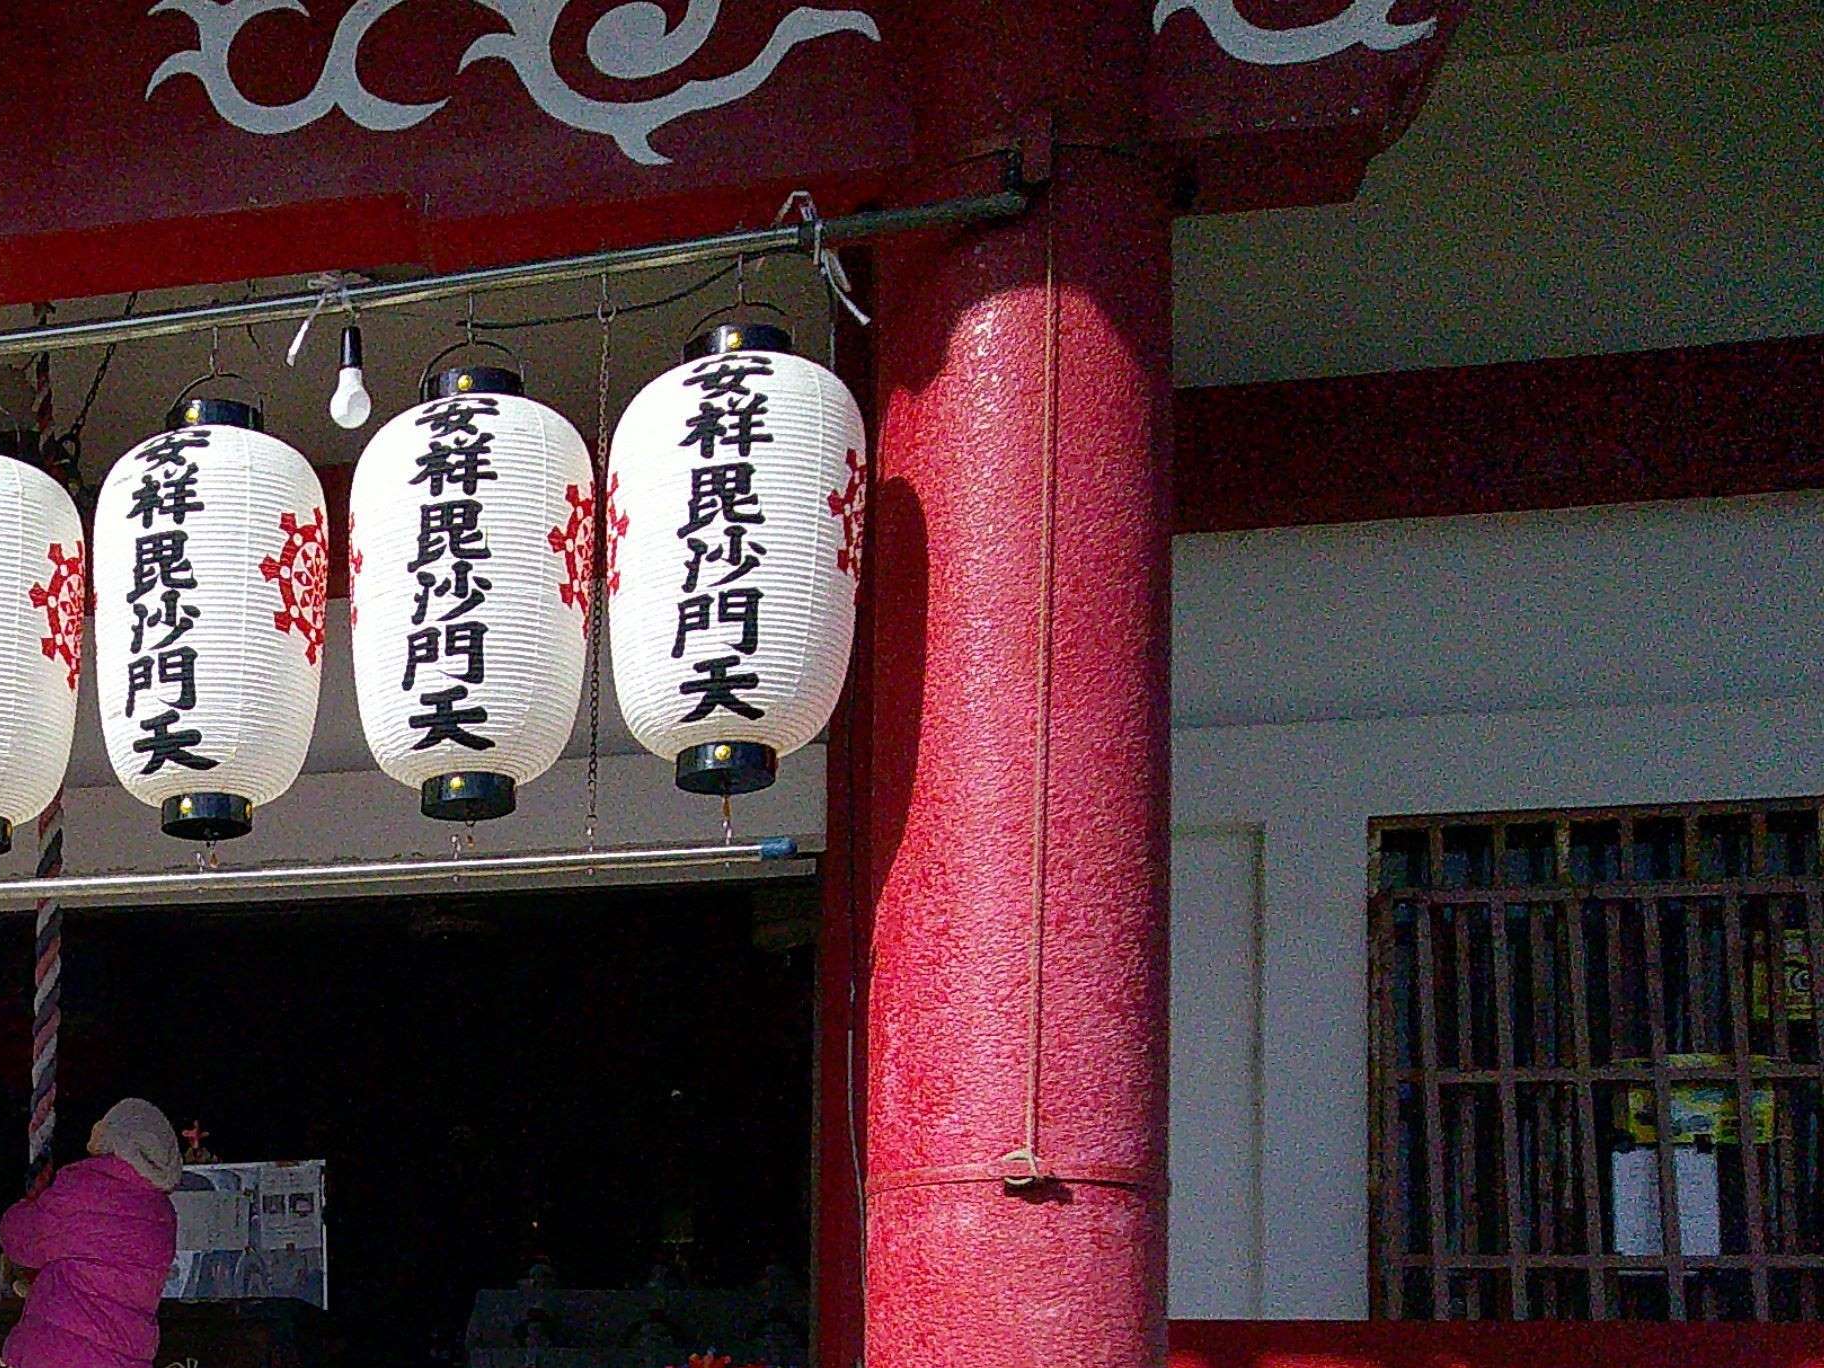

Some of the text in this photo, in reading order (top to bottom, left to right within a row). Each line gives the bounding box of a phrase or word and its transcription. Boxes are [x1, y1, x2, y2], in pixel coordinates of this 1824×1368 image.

[124, 429, 219, 776] 安祥毘沙門天
[401, 398, 499, 751] 安祥毘沙門天
[669, 353, 773, 723] 安祥毘沙門天
